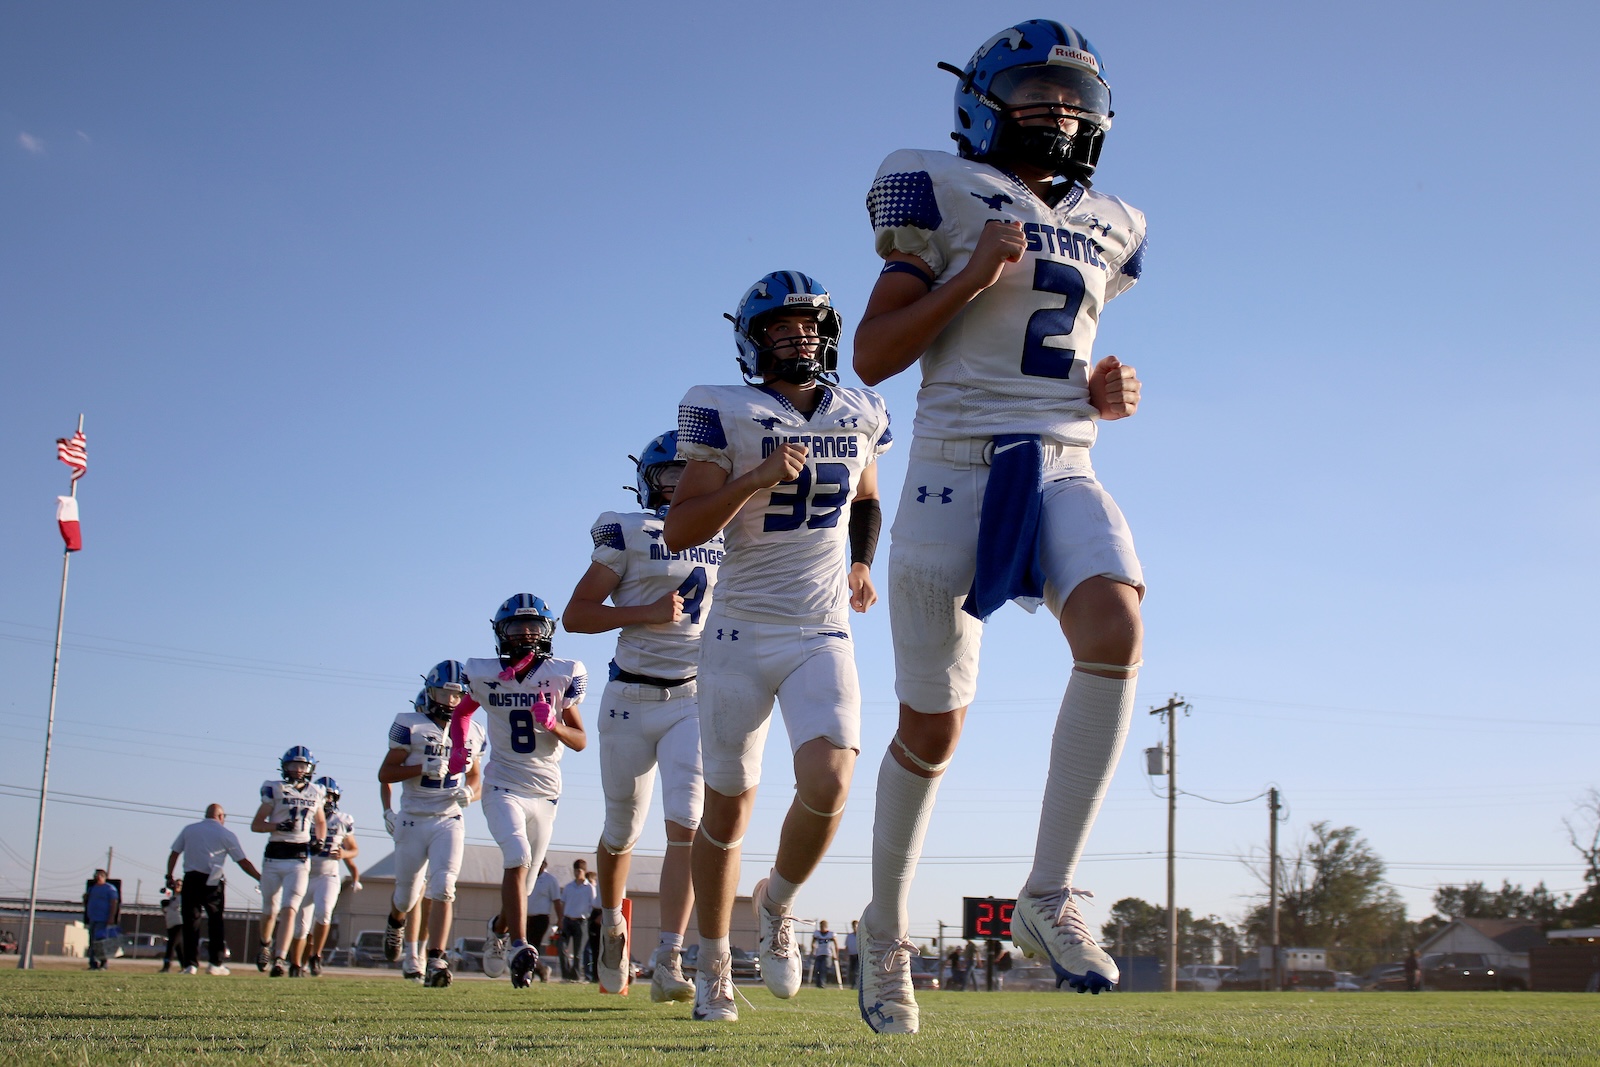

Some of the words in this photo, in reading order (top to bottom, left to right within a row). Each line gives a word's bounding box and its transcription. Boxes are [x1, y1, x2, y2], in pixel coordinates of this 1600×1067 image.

[1055, 48, 1095, 65] Riddell
[985, 219, 1106, 271] STANG
[1020, 258, 1085, 379] 2
[763, 462, 851, 532] 33
[676, 566, 708, 624] 4
[509, 709, 536, 753] 8
[282, 797, 316, 807] MUSTANGS
[289, 806, 310, 832] 11
[975, 903, 1016, 936] 25
